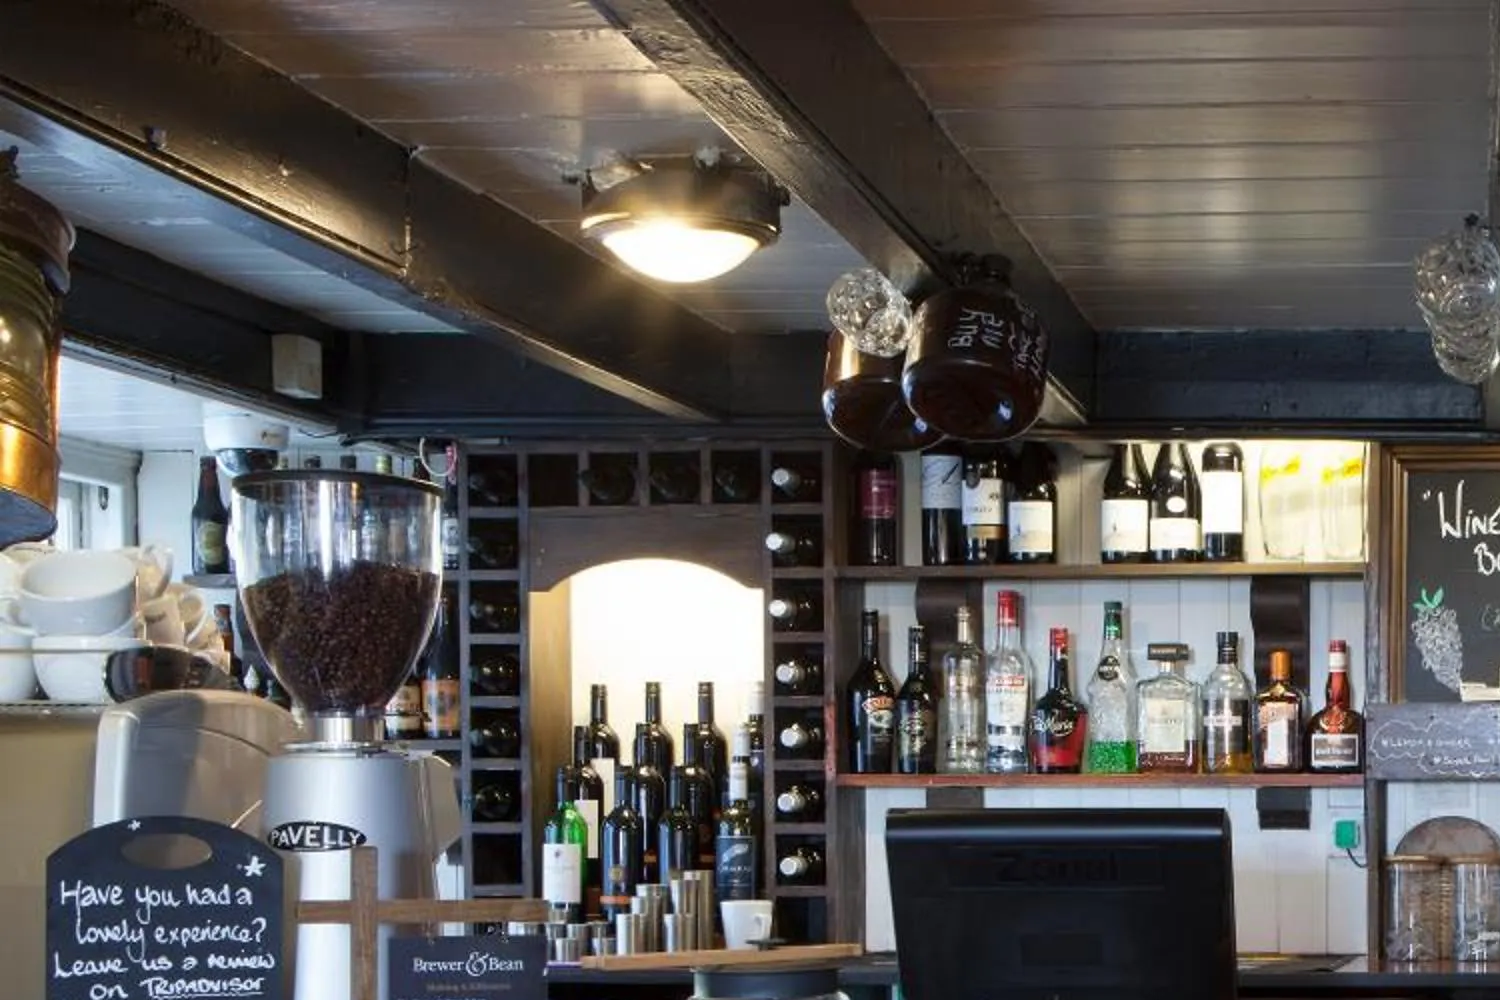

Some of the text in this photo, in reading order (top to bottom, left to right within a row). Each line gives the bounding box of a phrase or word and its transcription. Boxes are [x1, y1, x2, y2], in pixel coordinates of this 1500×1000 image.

[60, 880, 254, 926] Have you had a
[76, 917, 268, 963] lovely experience?
[54, 949, 276, 979] Leave us a review
[413, 951, 524, 977] Brewer & Bean
[89, 982, 129, 1000] on
